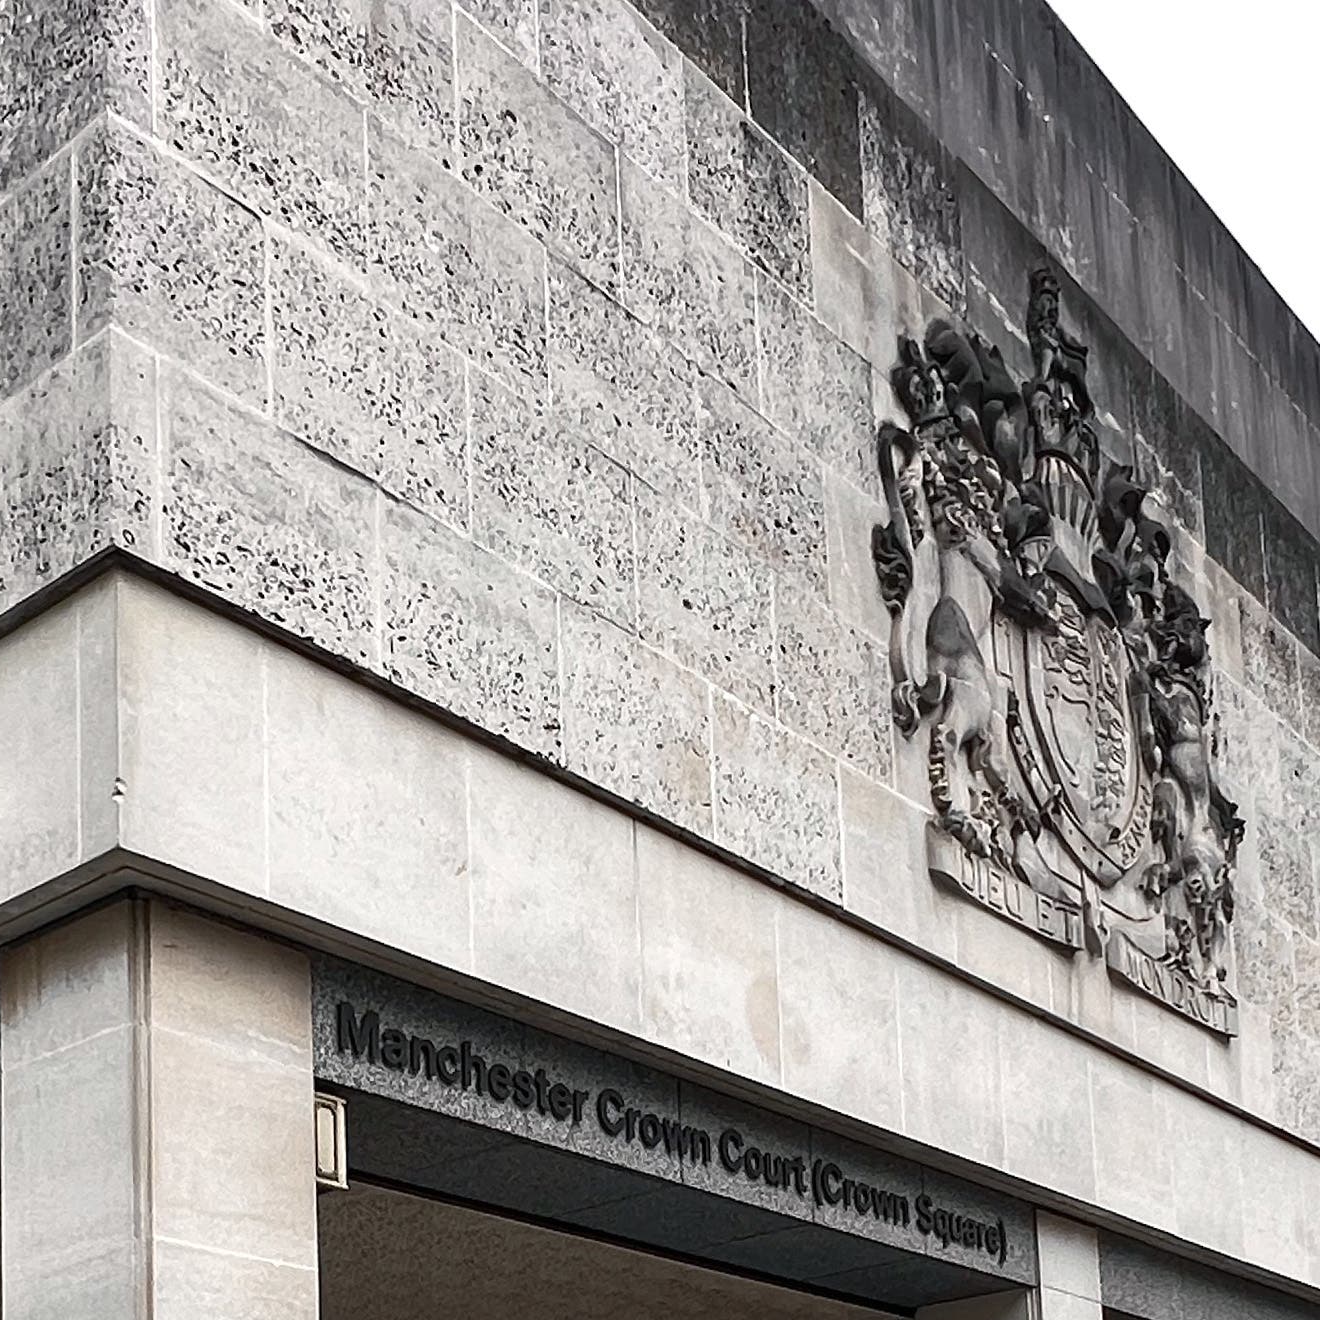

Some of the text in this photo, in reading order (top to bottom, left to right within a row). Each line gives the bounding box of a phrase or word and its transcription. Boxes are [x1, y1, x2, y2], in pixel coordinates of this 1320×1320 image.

[959, 852, 1023, 921] DIEU
[1035, 893, 1080, 943] ET
[335, 1000, 1007, 1268] Manchester Crown Court (Crown Square)
